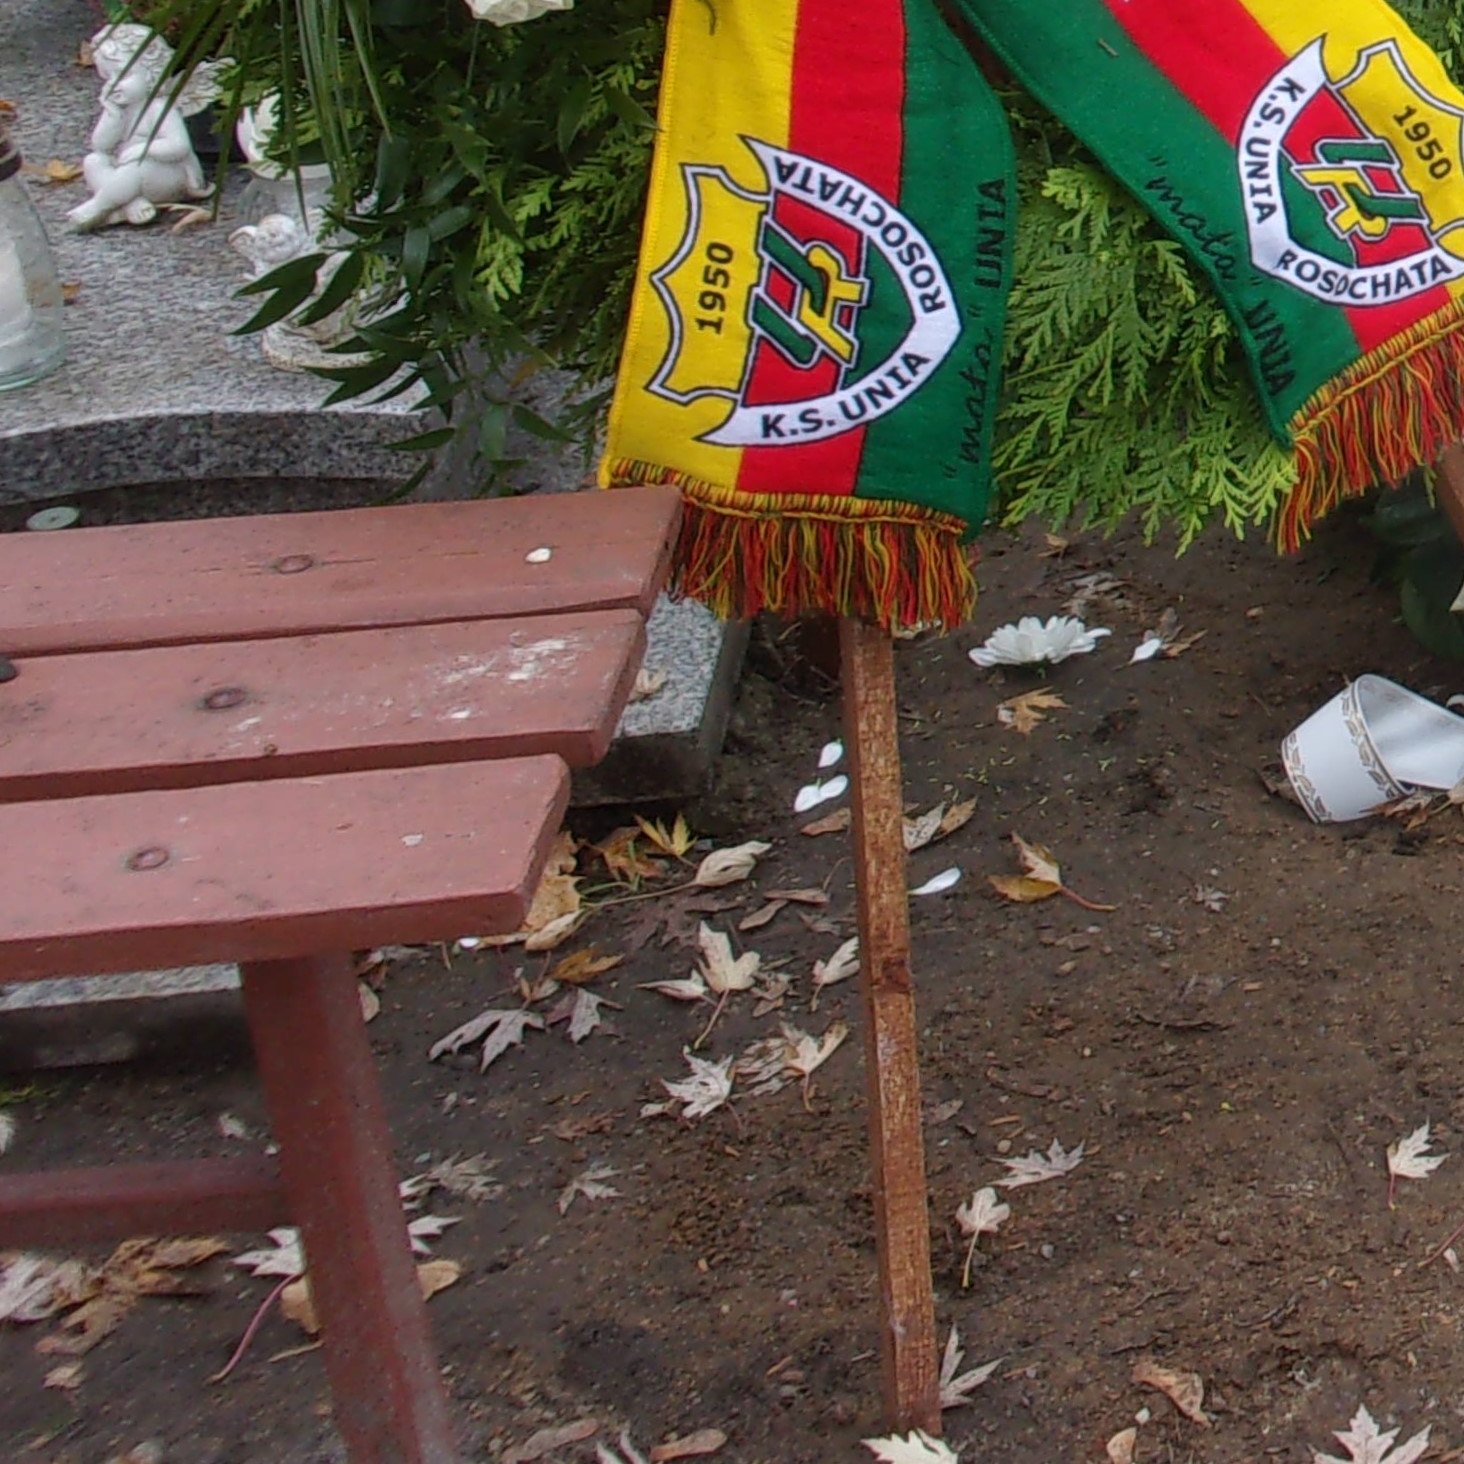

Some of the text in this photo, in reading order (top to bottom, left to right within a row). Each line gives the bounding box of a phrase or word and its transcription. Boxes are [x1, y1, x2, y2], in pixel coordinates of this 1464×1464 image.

[1244, 136, 1278, 225] UNIA
[1392, 104, 1454, 181] 1950
[774, 156, 947, 315] ROSOCHATA
[1275, 247, 1453, 301] ROSOCHATA
[694, 242, 734, 335] 1950
[848, 352, 931, 422] UNIA
